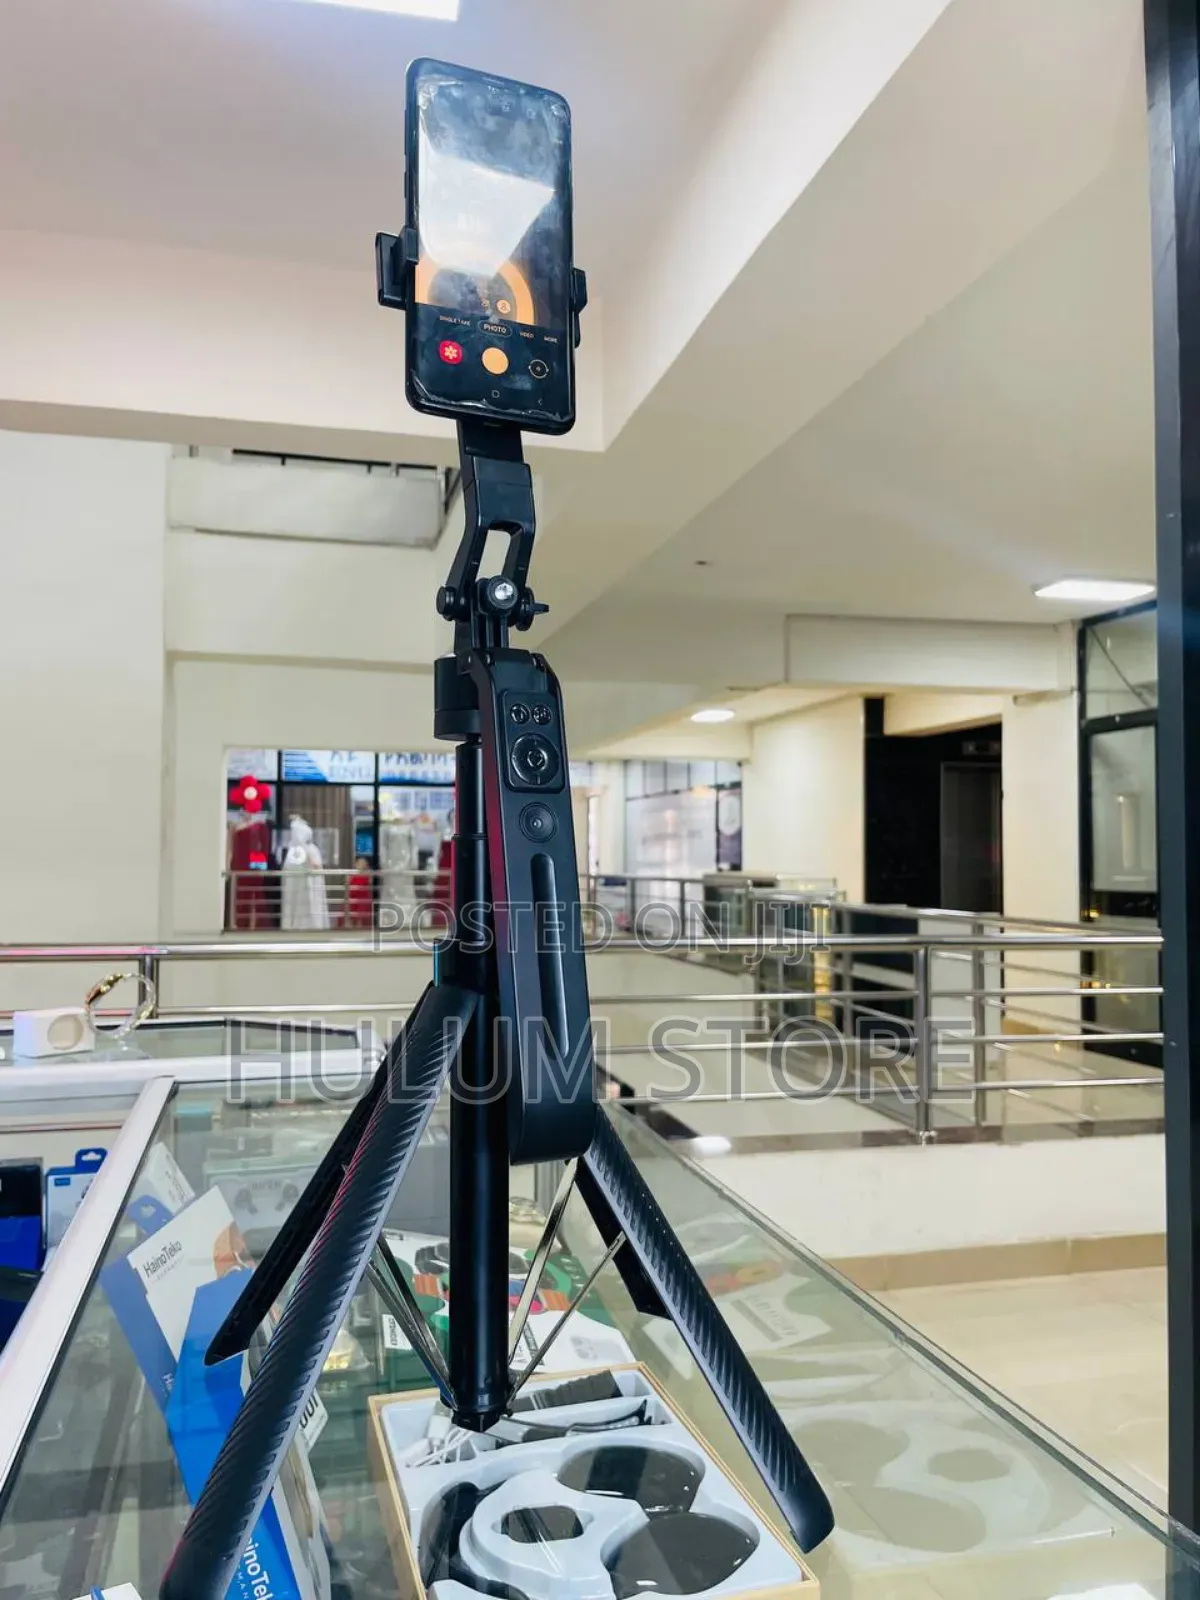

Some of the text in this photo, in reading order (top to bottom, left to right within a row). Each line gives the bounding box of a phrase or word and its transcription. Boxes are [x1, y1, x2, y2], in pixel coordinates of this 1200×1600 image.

[483, 323, 507, 334] PHOTO
[519, 331, 535, 339] VIDEO
[543, 336, 558, 344] MORE
[142, 1240, 183, 1278] HainoTeko
